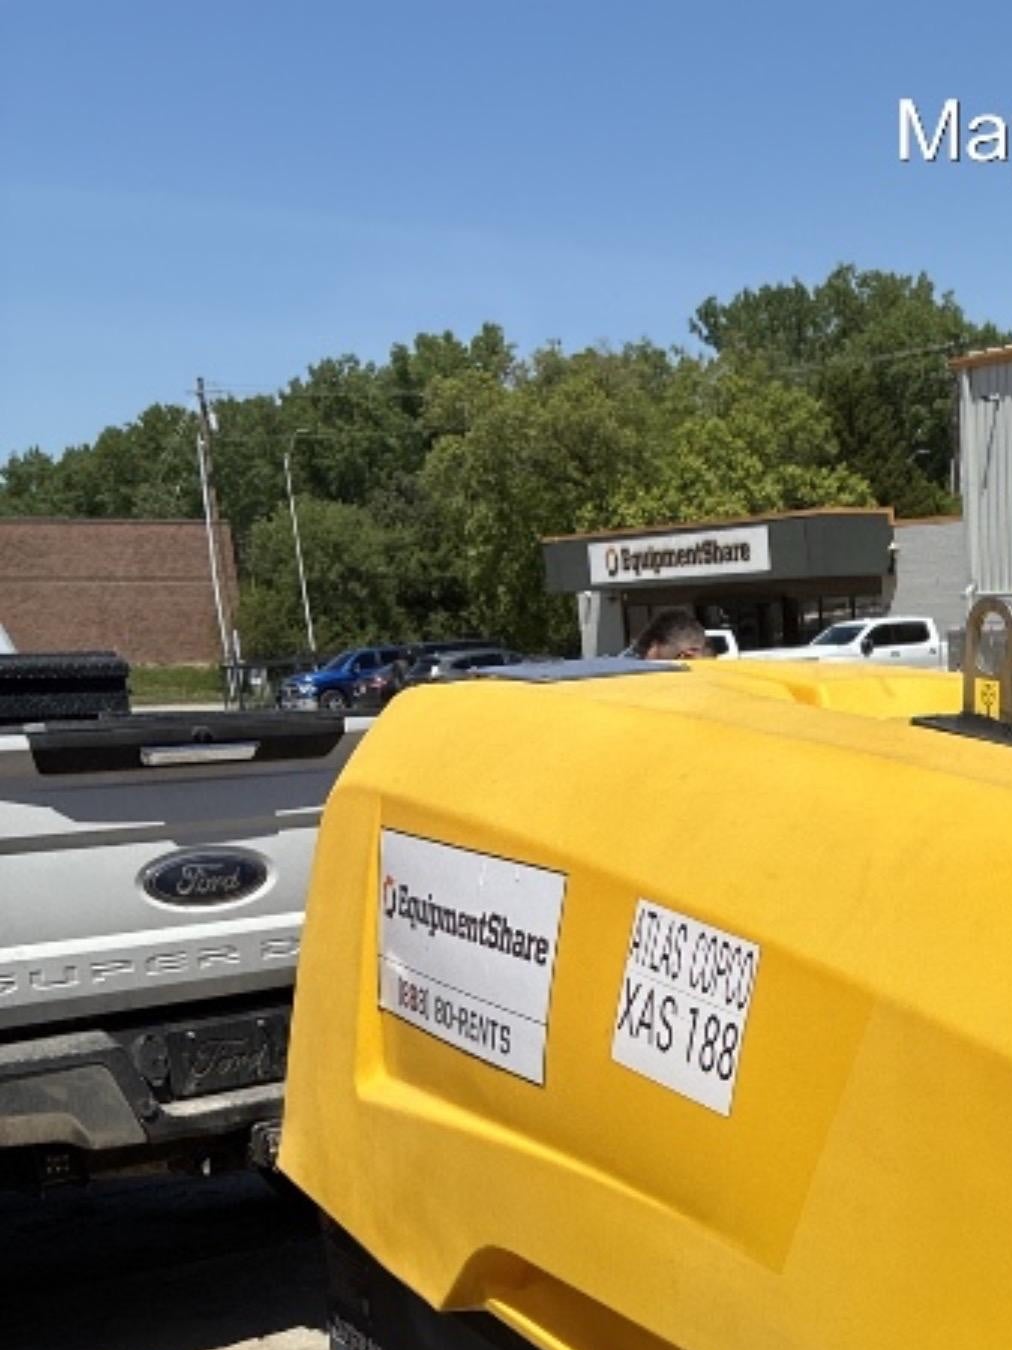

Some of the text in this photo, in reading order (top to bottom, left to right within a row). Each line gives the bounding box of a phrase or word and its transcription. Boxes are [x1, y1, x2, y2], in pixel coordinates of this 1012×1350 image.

[620, 539, 751, 576] EquipmentShare
[176, 862, 241, 895] Ford
[398, 884, 549, 966] EquipmentShare
[630, 908, 754, 1010] ATLAS COPCO
[434, 994, 511, 1055] 80-RENTS
[617, 977, 738, 1081] XAS 188
